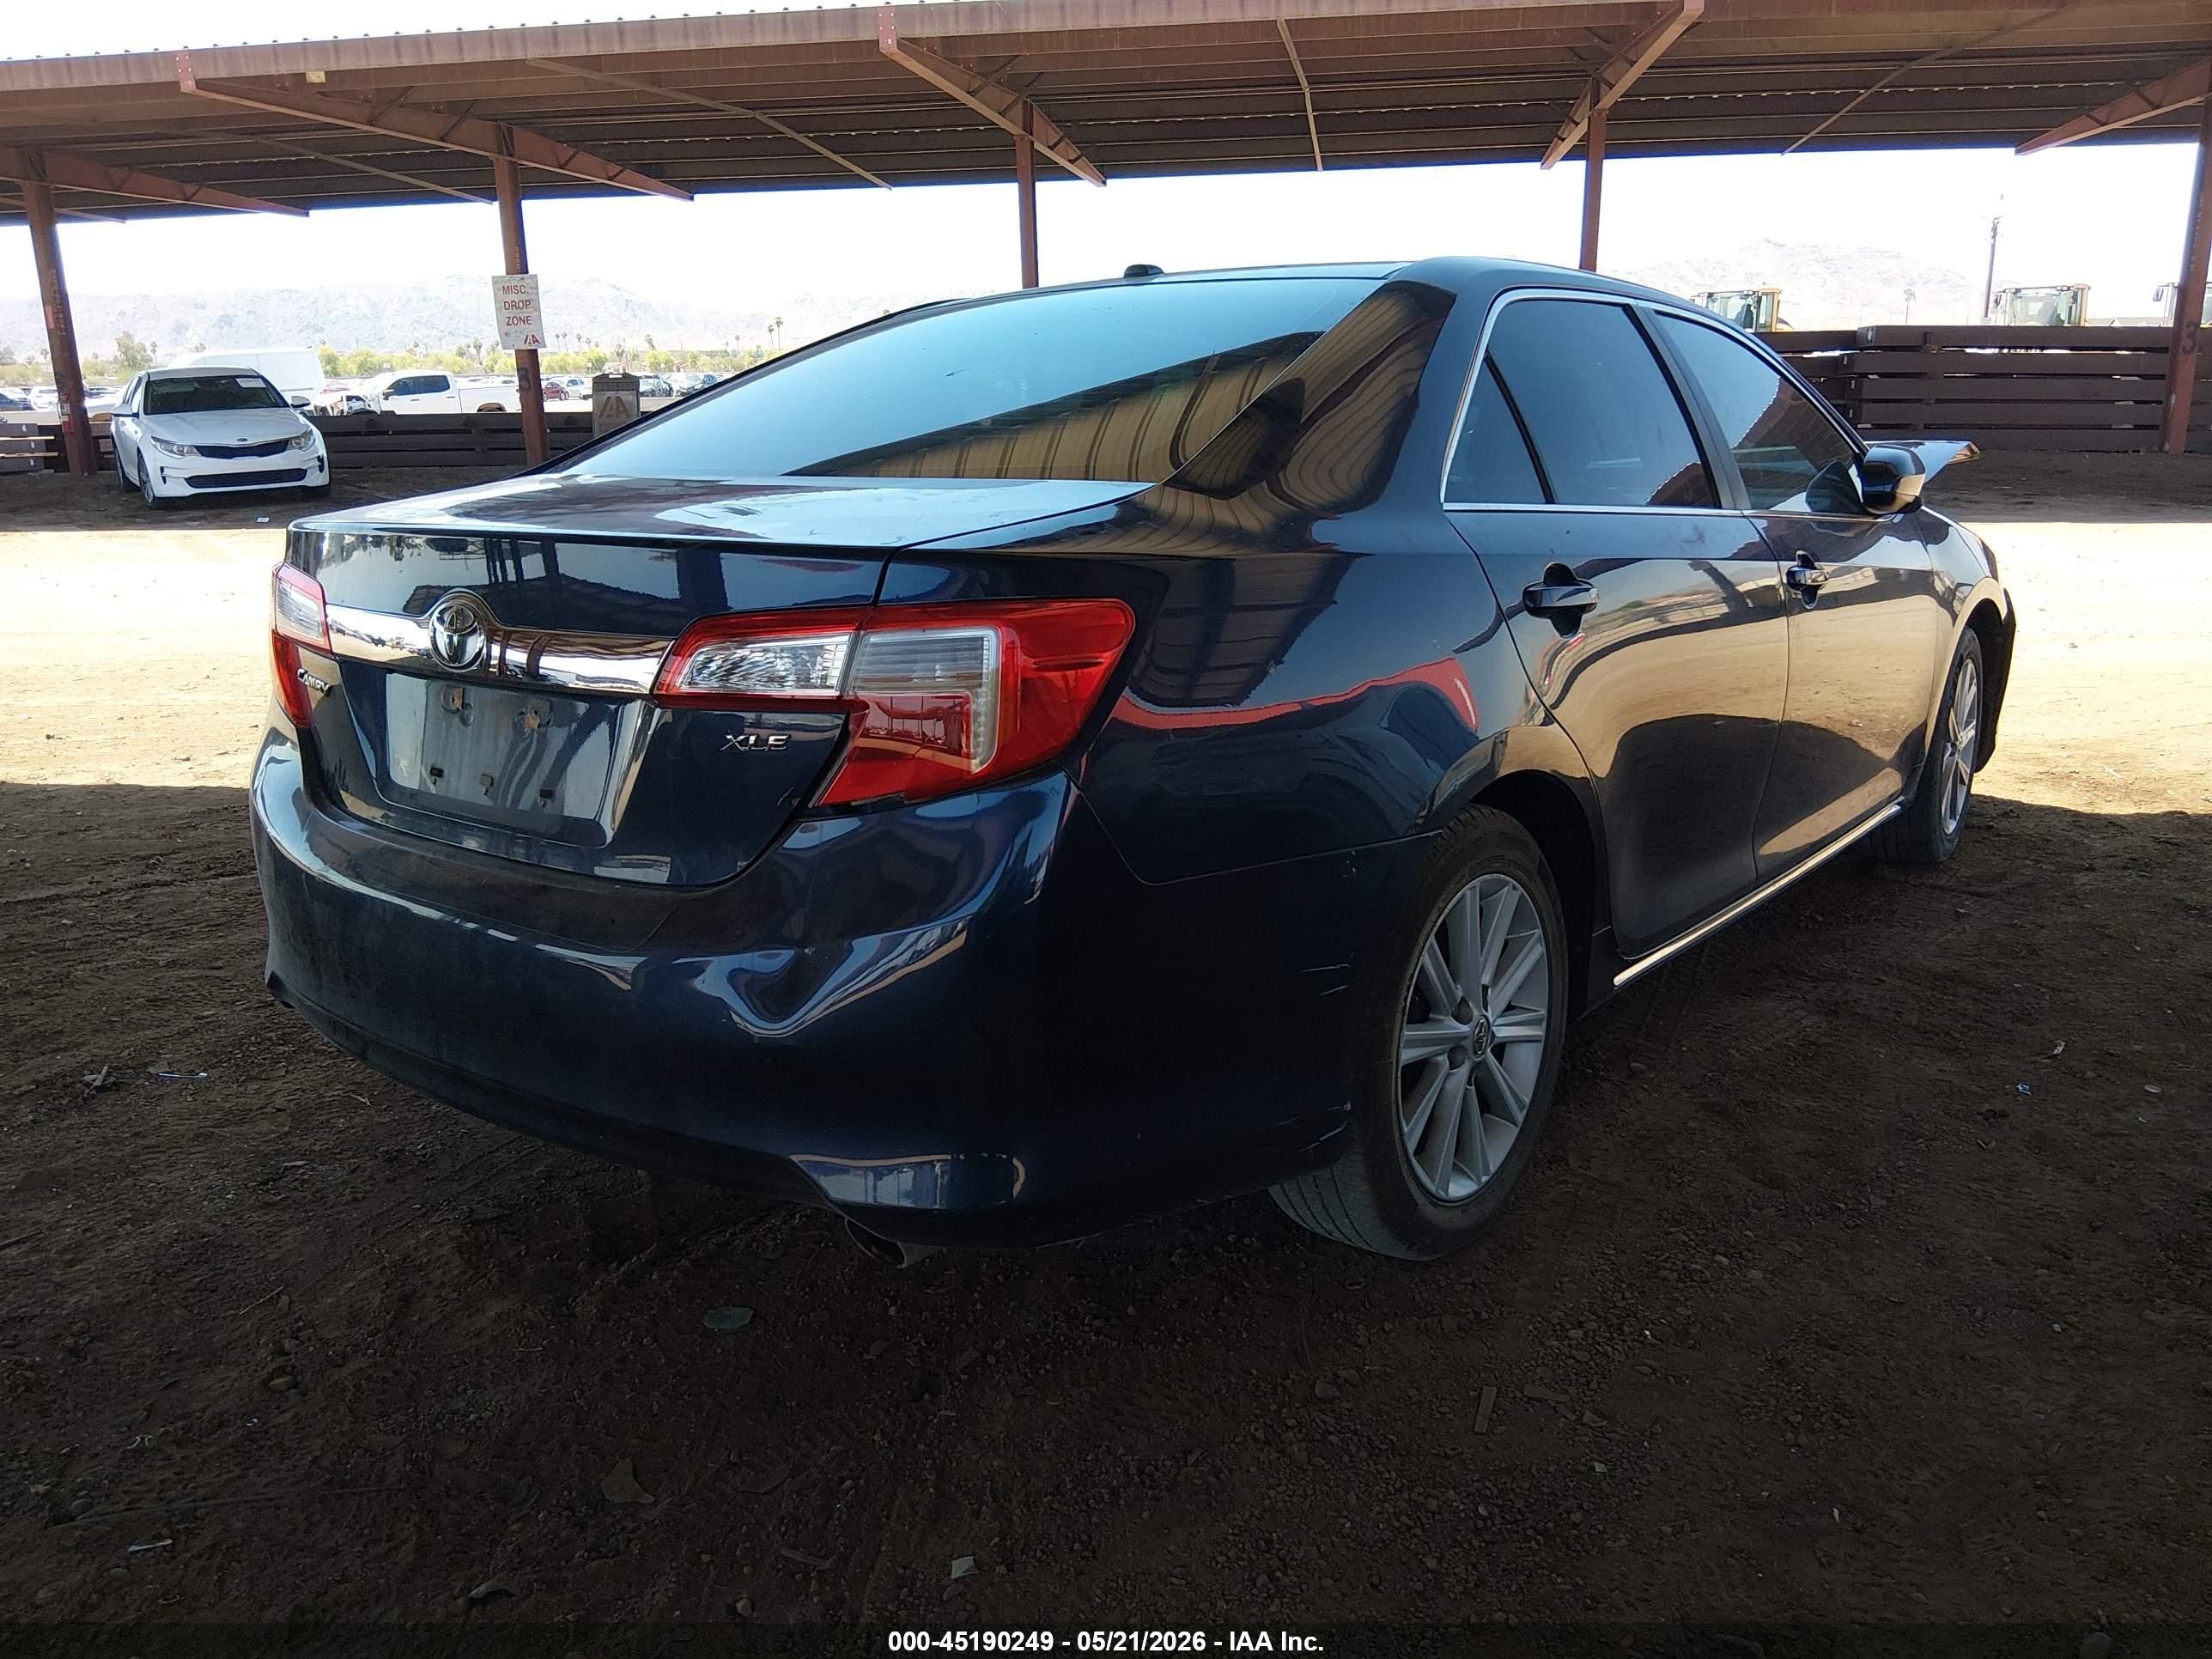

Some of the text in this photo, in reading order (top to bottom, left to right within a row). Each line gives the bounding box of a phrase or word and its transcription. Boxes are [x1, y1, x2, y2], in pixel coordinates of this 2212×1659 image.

[502, 284, 529, 295] MISC.
[503, 300, 531, 310] DROP
[505, 315, 532, 325] ZONE
[720, 734, 789, 751] XLE
